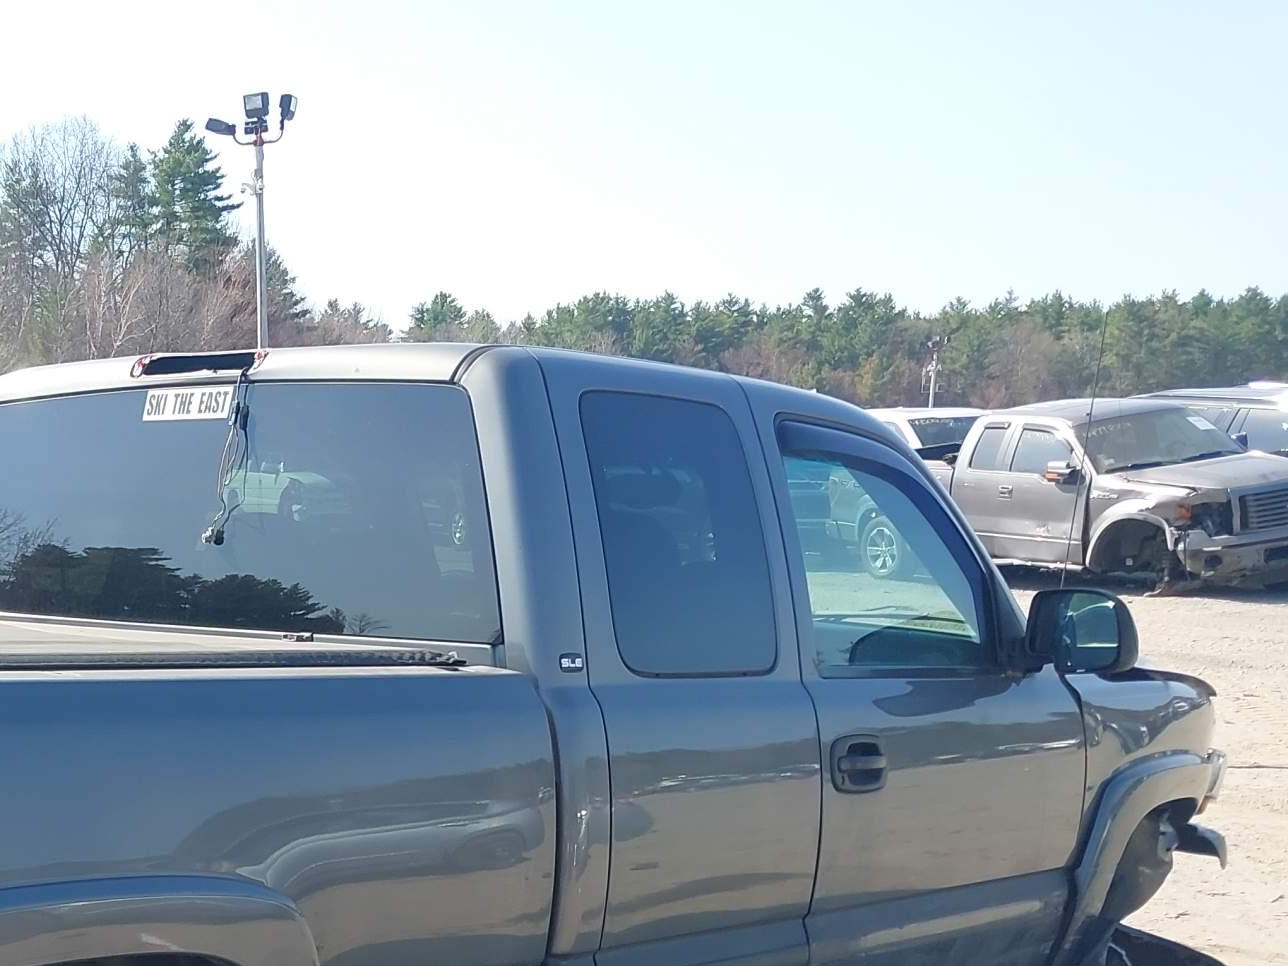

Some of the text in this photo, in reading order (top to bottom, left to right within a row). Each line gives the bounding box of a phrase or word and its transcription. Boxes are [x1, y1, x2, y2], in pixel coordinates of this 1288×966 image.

[147, 390, 230, 416] SKI THE EAST
[561, 658, 583, 668] SLE
